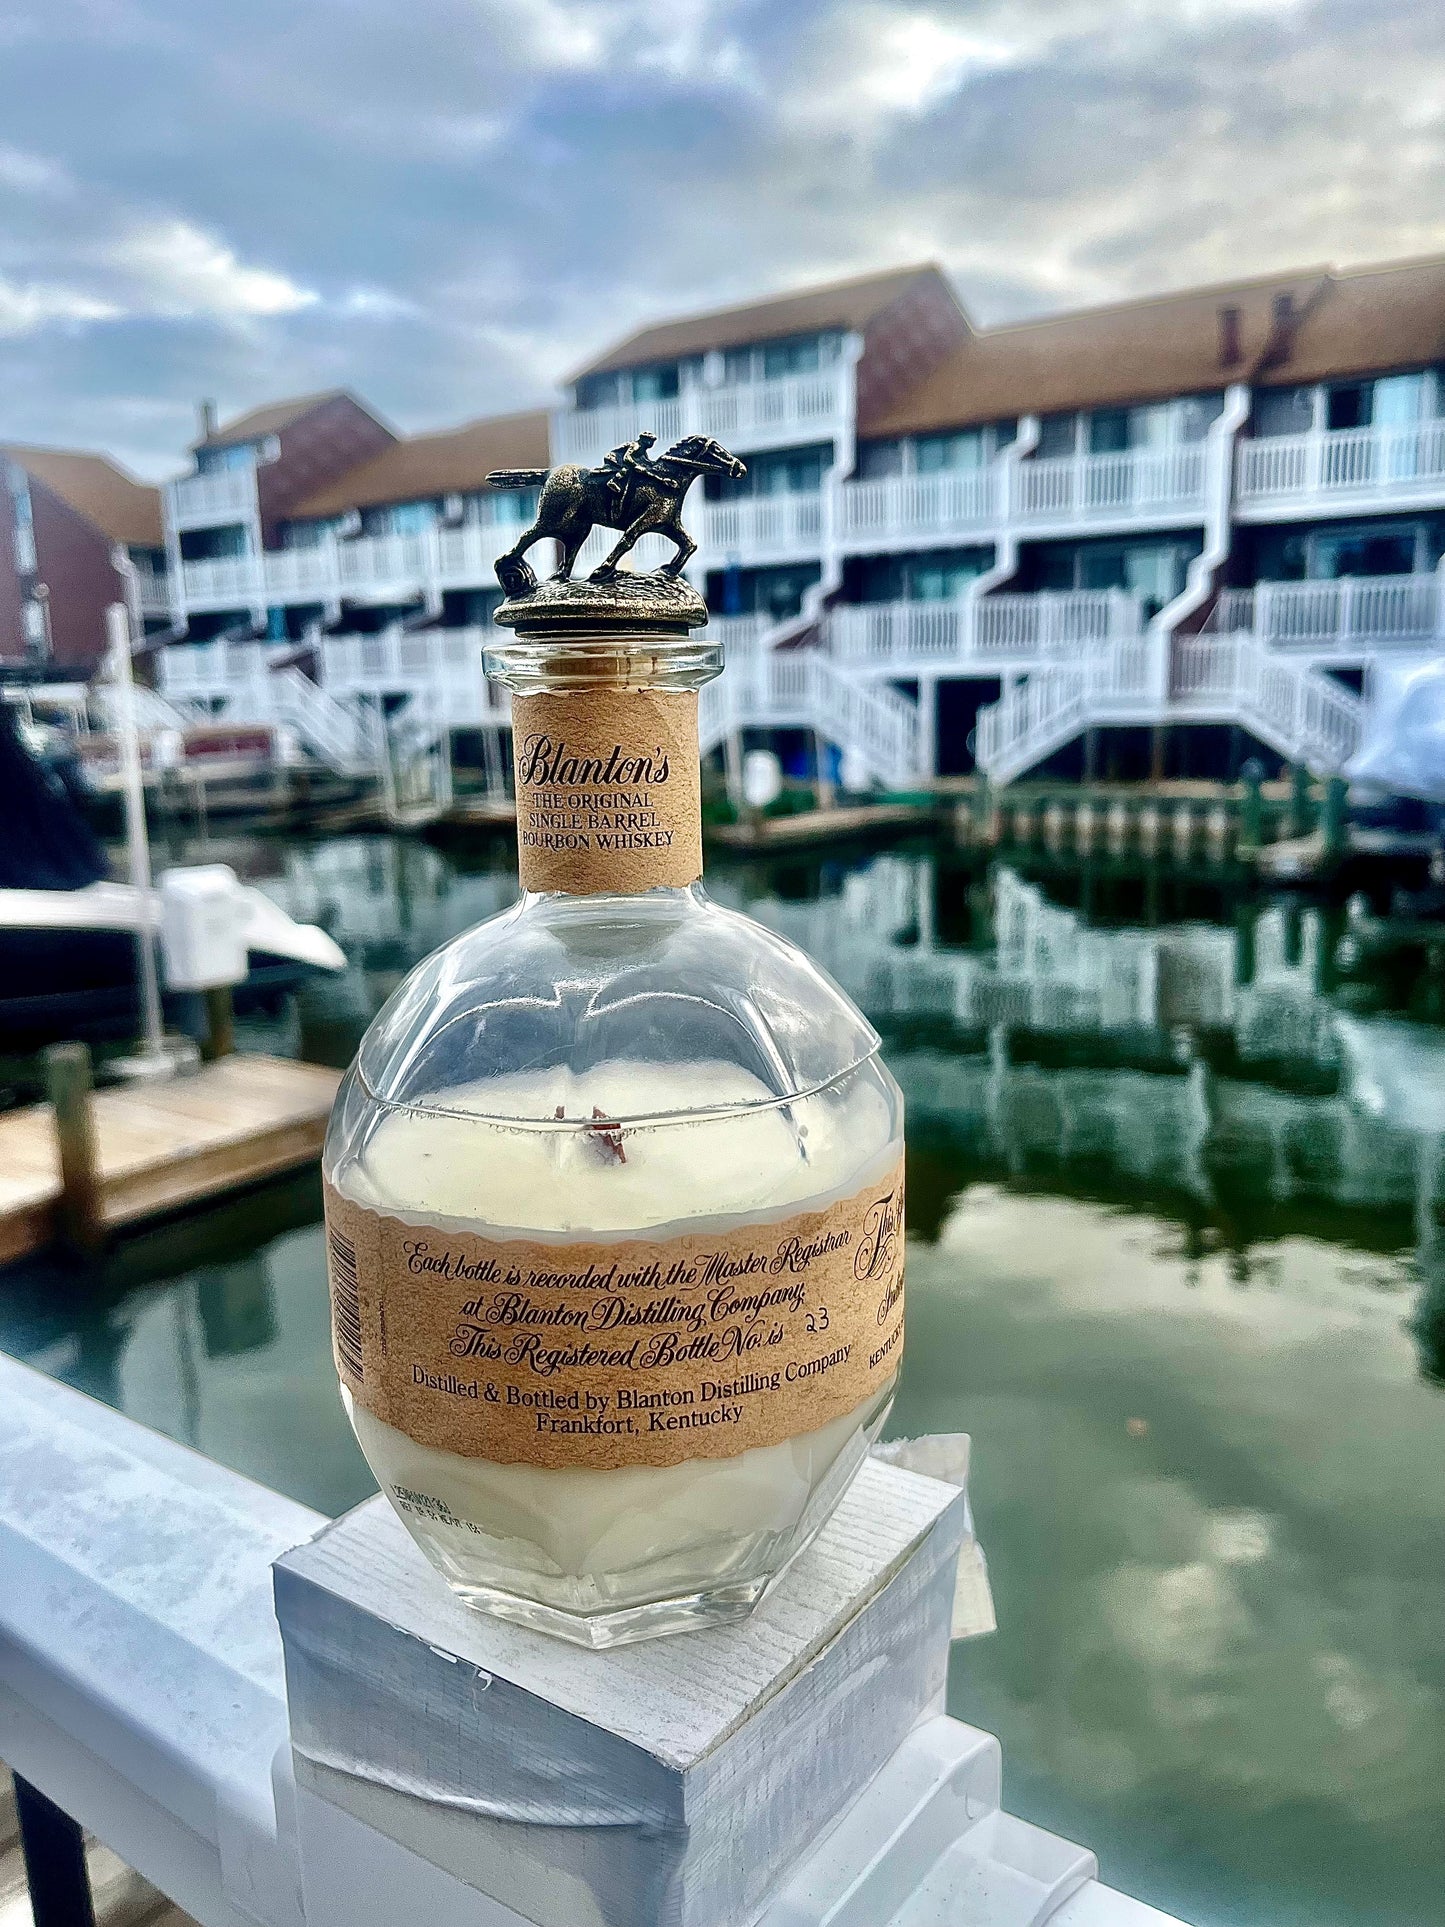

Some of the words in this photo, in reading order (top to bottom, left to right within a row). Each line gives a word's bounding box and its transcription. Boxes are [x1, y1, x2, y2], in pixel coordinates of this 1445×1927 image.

[519, 733, 669, 786] Blanton's
[530, 812, 582, 829] SINGLE
[588, 812, 660, 831] BARREL
[533, 793, 564, 809] THE
[568, 793, 653, 812] ORIGINAL
[523, 831, 590, 852] BOURBON
[595, 830, 674, 849] WHISKEY
[403, 1240, 454, 1280] Each
[453, 1254, 501, 1284] bottle
[503, 1265, 521, 1286] is
[522, 1264, 618, 1292] recorded
[618, 1262, 665, 1290] with
[662, 1260, 697, 1285] the
[680, 1252, 768, 1291] Master
[769, 1230, 852, 1274] Registrar
[459, 1296, 486, 1322] at
[486, 1292, 589, 1334] Blanton
[587, 1296, 706, 1332] Distilling
[707, 1283, 805, 1322] Company.
[450, 1324, 502, 1357] This
[504, 1333, 639, 1377] Registered
[640, 1331, 720, 1369] Bottle
[713, 1320, 765, 1362] No.
[766, 1322, 784, 1345] is
[805, 1307, 829, 1333] 23
[412, 1364, 479, 1398] Distilled
[484, 1382, 500, 1402] &
[506, 1385, 579, 1409] Bottled
[586, 1390, 610, 1413] by
[617, 1389, 693, 1409] Blanton
[701, 1371, 780, 1402] Distilling
[785, 1344, 851, 1383] Company
[536, 1412, 639, 1435] Frankfort,
[649, 1402, 743, 1431] Kentucky
